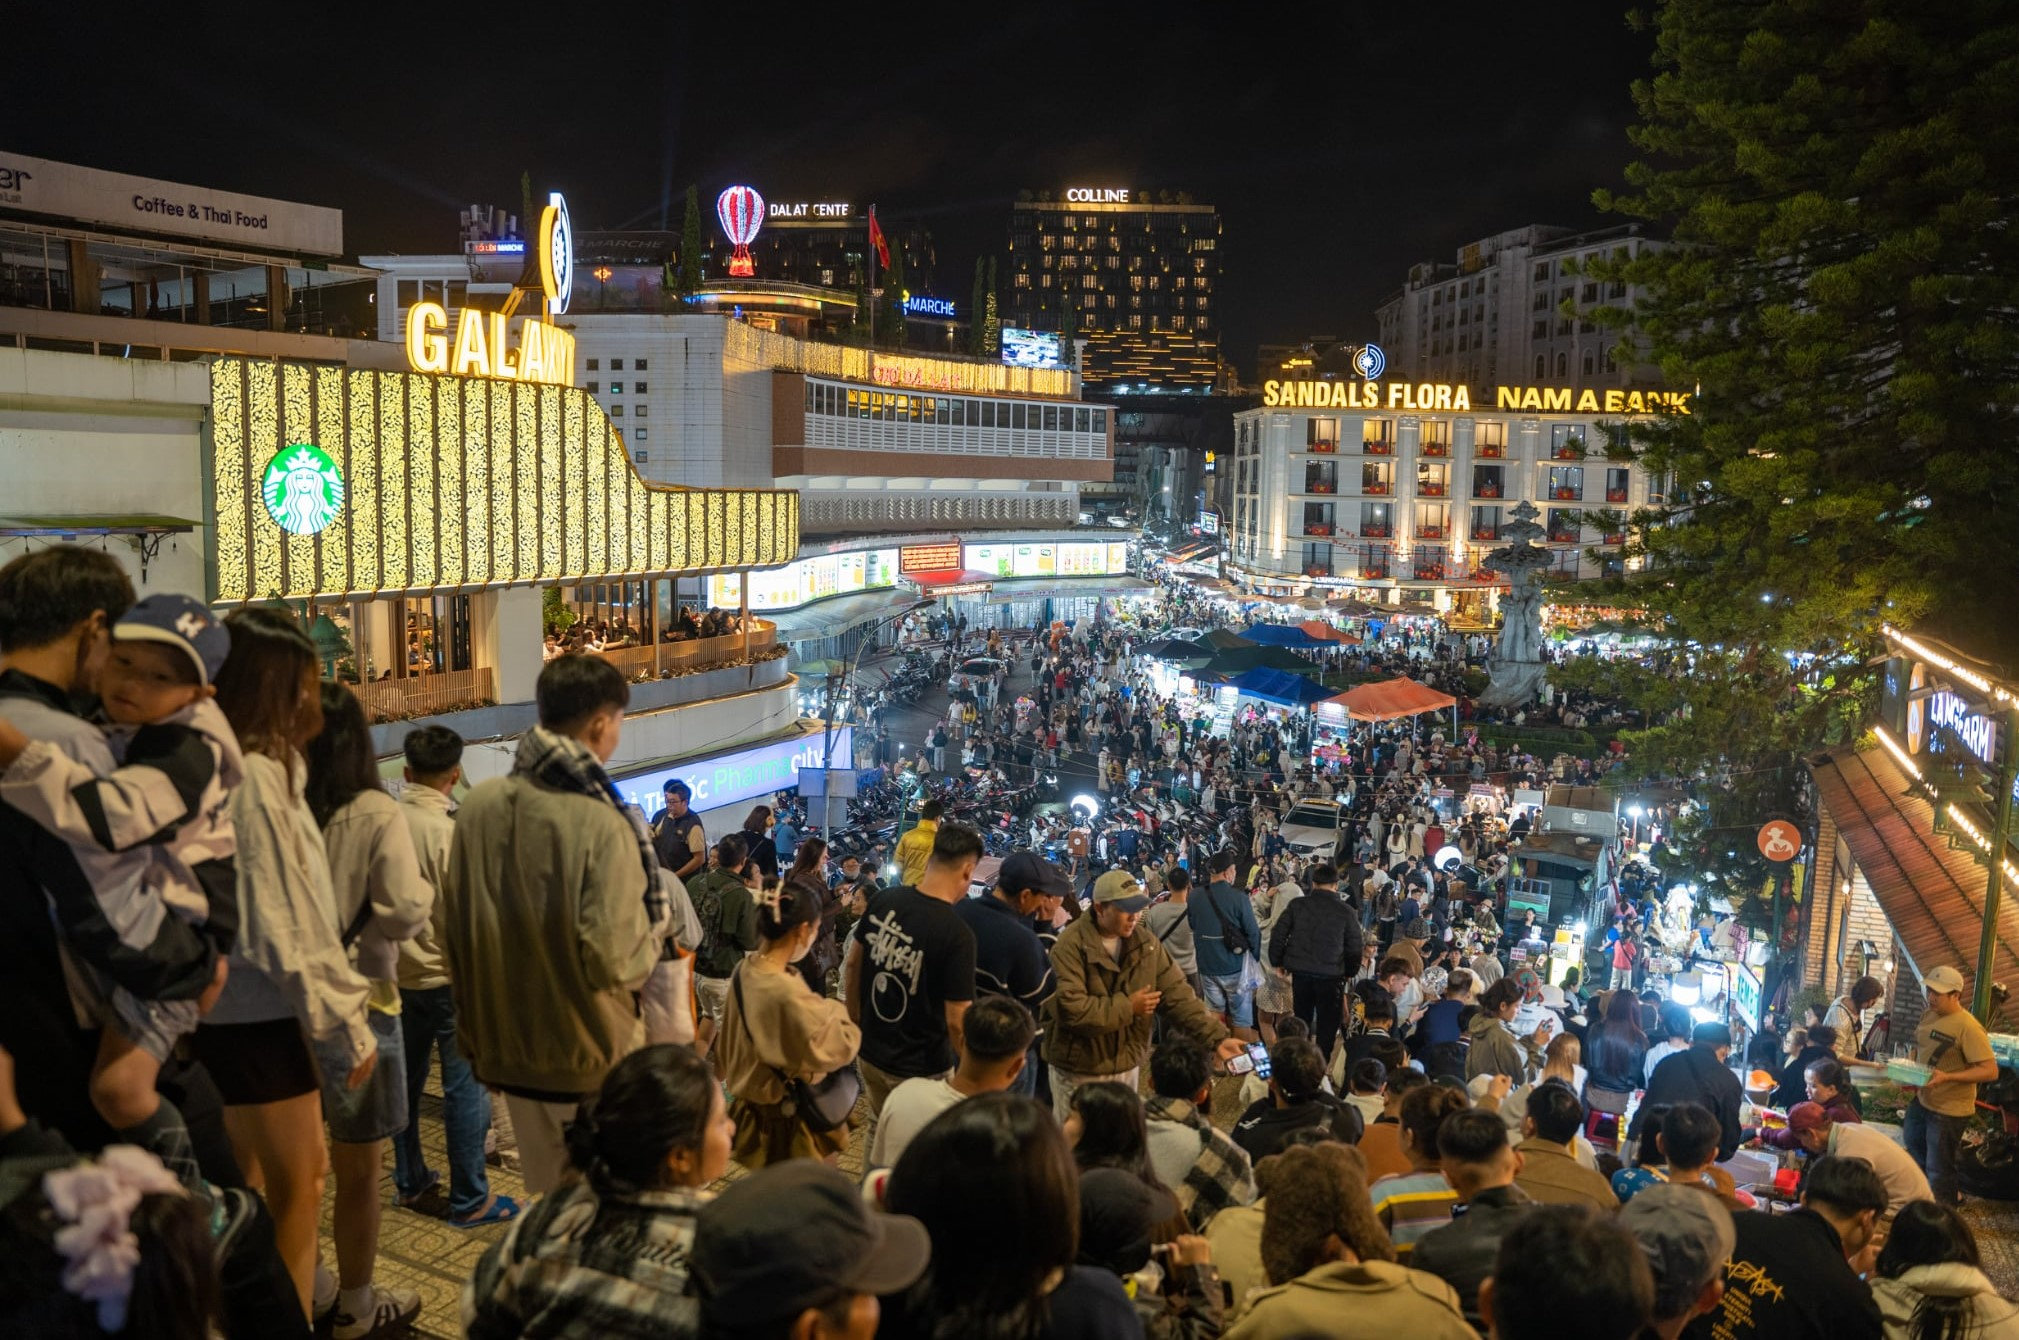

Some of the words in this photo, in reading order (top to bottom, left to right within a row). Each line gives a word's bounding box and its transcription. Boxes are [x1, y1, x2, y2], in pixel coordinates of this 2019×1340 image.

[770, 203, 808, 216] DALAT
[1067, 188, 1129, 202] COLLINE
[133, 195, 184, 217] Coffee
[188, 204, 199, 219] &
[202, 205, 232, 225] Thai
[235, 212, 268, 229] Food
[1263, 380, 1379, 408] SANDALS
[1388, 383, 1470, 411] FLORA
[1497, 386, 1571, 411] NAM
[1605, 390, 1692, 415] BANK
[713, 743, 824, 796] Pharmacity
